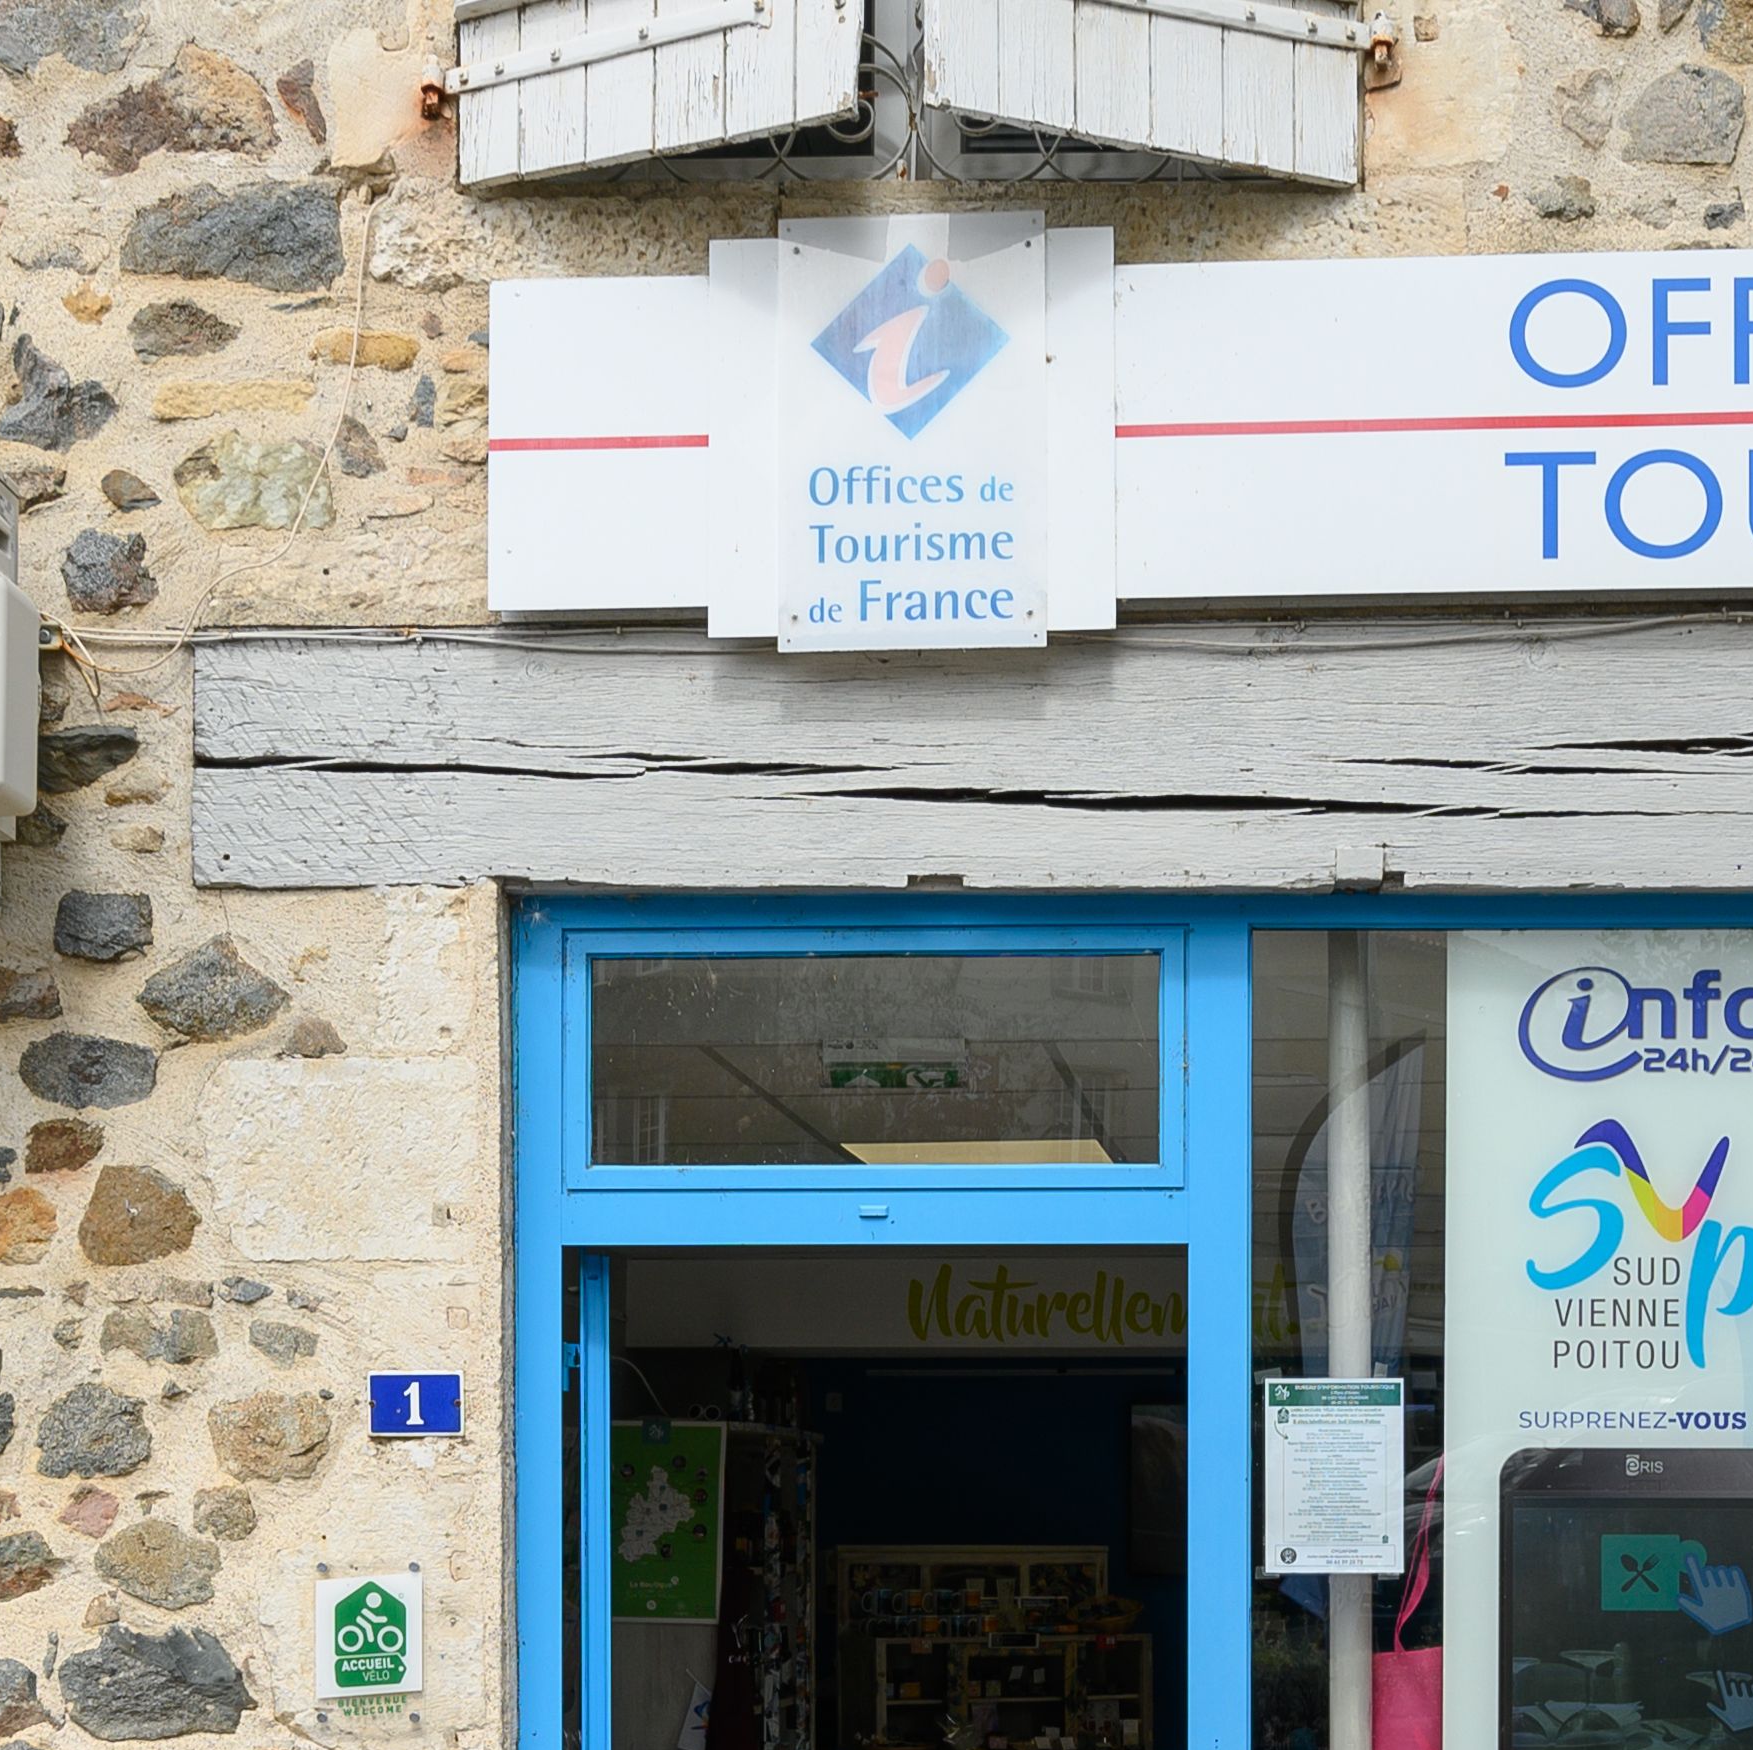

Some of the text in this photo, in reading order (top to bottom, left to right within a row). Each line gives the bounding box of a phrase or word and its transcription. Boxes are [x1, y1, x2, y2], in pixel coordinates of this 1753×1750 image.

[808, 465, 1014, 506] Offices de
[809, 523, 1014, 563] Tourisme
[809, 578, 1014, 623] de France
[1612, 1257, 1681, 1286] SUD
[1553, 1298, 1681, 1327] VIENNE
[1553, 1339, 1681, 1369] POITOU
[403, 1381, 425, 1426] 1
[1518, 1410, 1748, 1431] SURPRENEZ-VOUS
[341, 1657, 395, 1672] ACCUEIL
[362, 1669, 390, 1682] VÉLO
[337, 1695, 407, 1708] BIENVENUE
[343, 1705, 402, 1717] WELCOME
